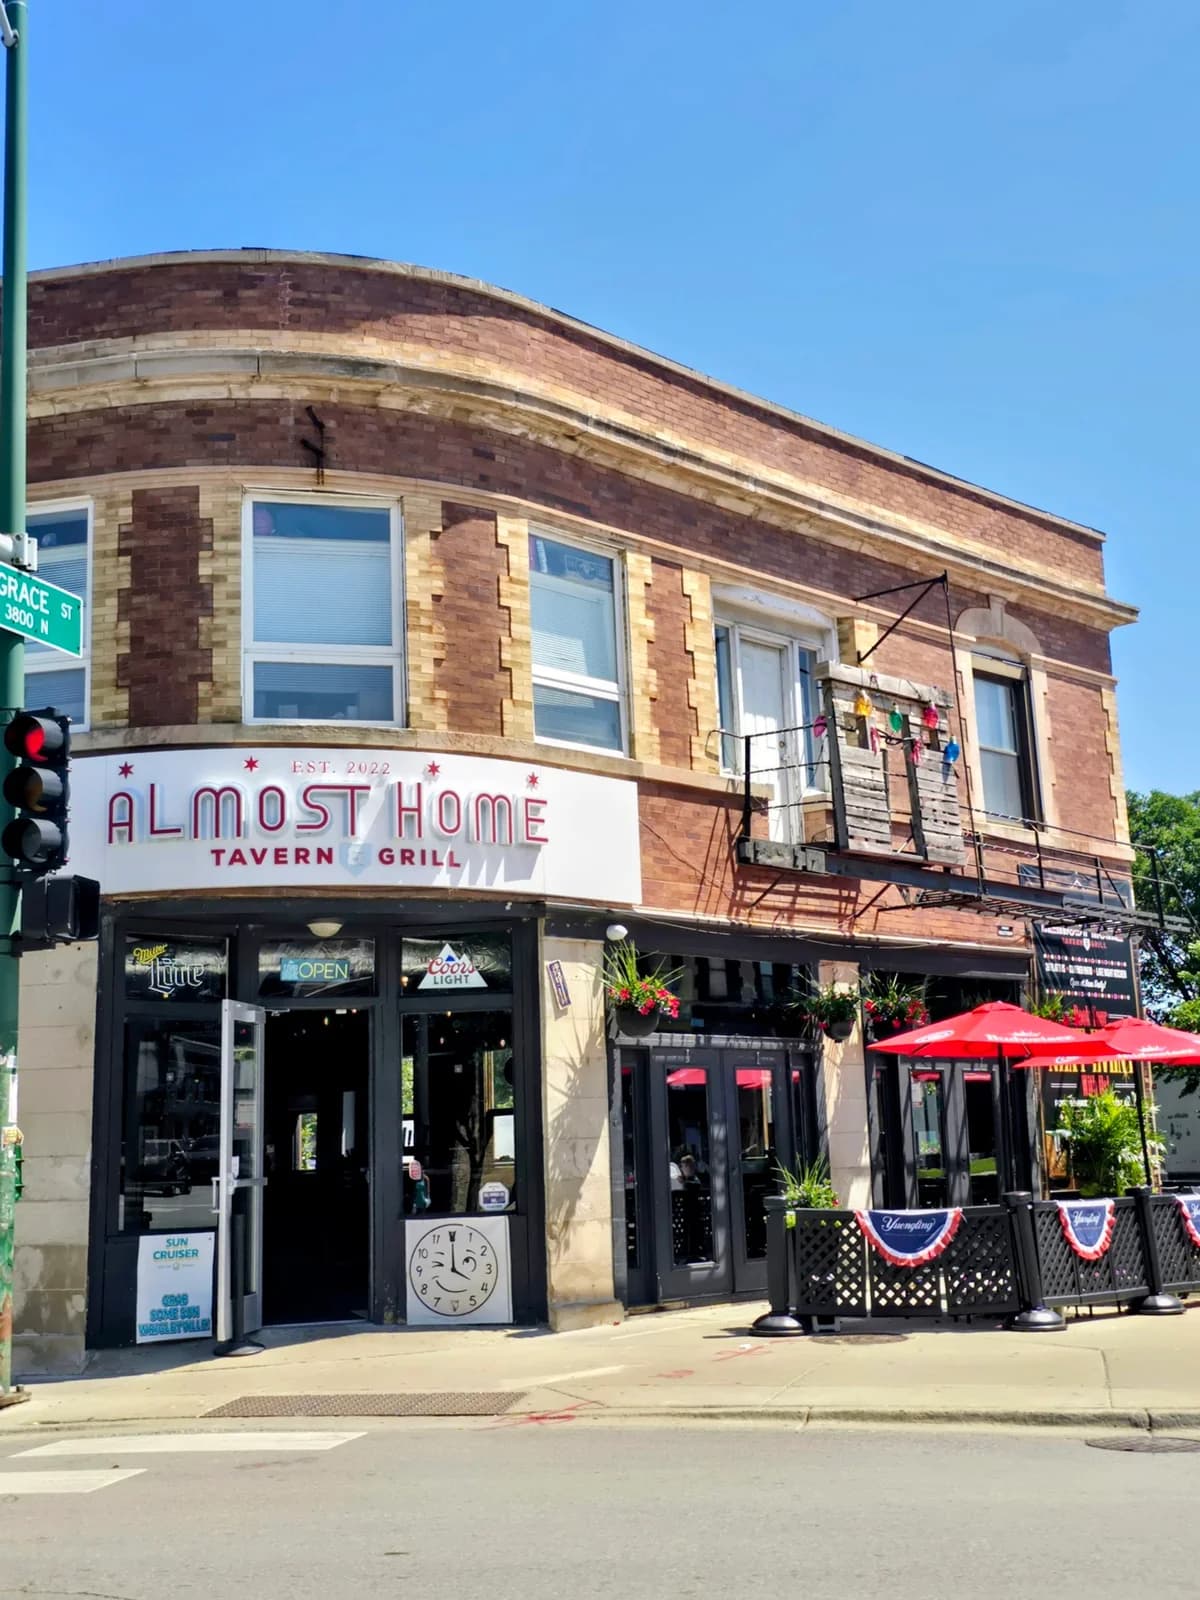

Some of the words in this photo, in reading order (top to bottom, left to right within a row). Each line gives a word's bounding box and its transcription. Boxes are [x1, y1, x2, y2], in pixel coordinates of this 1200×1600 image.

[0, 571, 49, 615] GRACE
[61, 603, 73, 620] ST
[5, 604, 34, 629] 3800
[40, 618, 49, 635] N
[291, 760, 336, 774] EST.
[347, 761, 390, 775] 2022
[108, 783, 371, 844] ALMOST
[397, 781, 549, 845] HOME
[210, 847, 333, 866] TAVERN
[378, 847, 461, 868] GRILL
[133, 944, 168, 964] Miller
[299, 962, 348, 978] OPEN
[428, 956, 475, 976] Coors
[433, 974, 470, 985] LIGHT
[881, 1216, 936, 1232] Yuengling
[166, 1238, 188, 1247] SUN
[432, 1234, 441, 1244] 11
[468, 1232, 473, 1242] 1
[153, 1249, 199, 1260] CRUISER
[418, 1248, 429, 1259] 10
[480, 1245, 488, 1256] 2
[416, 1266, 423, 1277] 9
[486, 1263, 493, 1275] 3
[420, 1283, 428, 1295] 8
[481, 1282, 488, 1293] 4
[433, 1297, 441, 1308] 7
[469, 1296, 477, 1306] 5
